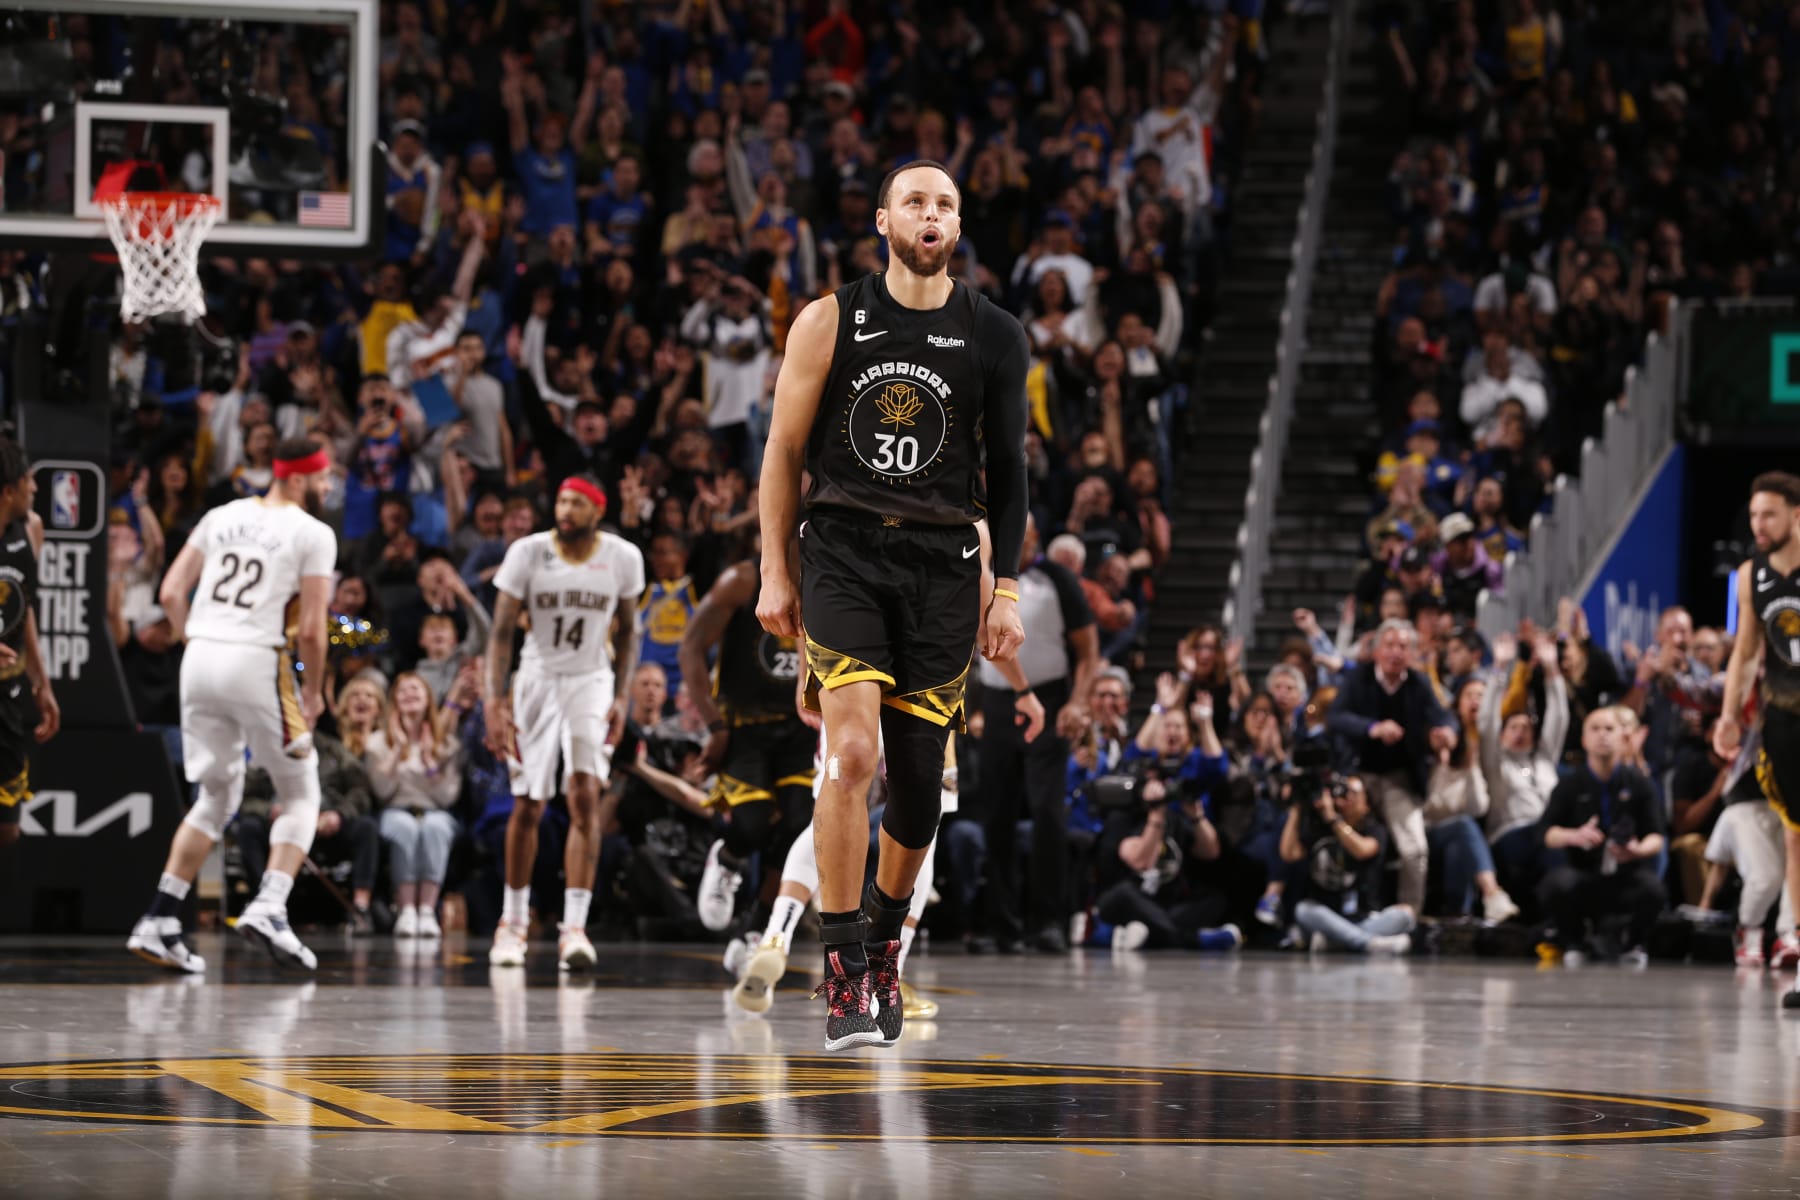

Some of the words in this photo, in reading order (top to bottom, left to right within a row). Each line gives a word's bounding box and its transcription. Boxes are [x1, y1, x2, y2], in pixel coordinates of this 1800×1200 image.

[854, 309, 866, 324] 6
[927, 334, 965, 347] Rakuten
[851, 362, 952, 399] WARRIORS
[871, 432, 919, 472] 30
[37, 542, 91, 587] GET
[211, 552, 264, 609] 22
[36, 588, 90, 633] THE
[553, 616, 586, 651] 14
[38, 635, 91, 679] APP
[772, 651, 799, 677] 23
[19, 789, 153, 838] KIA
